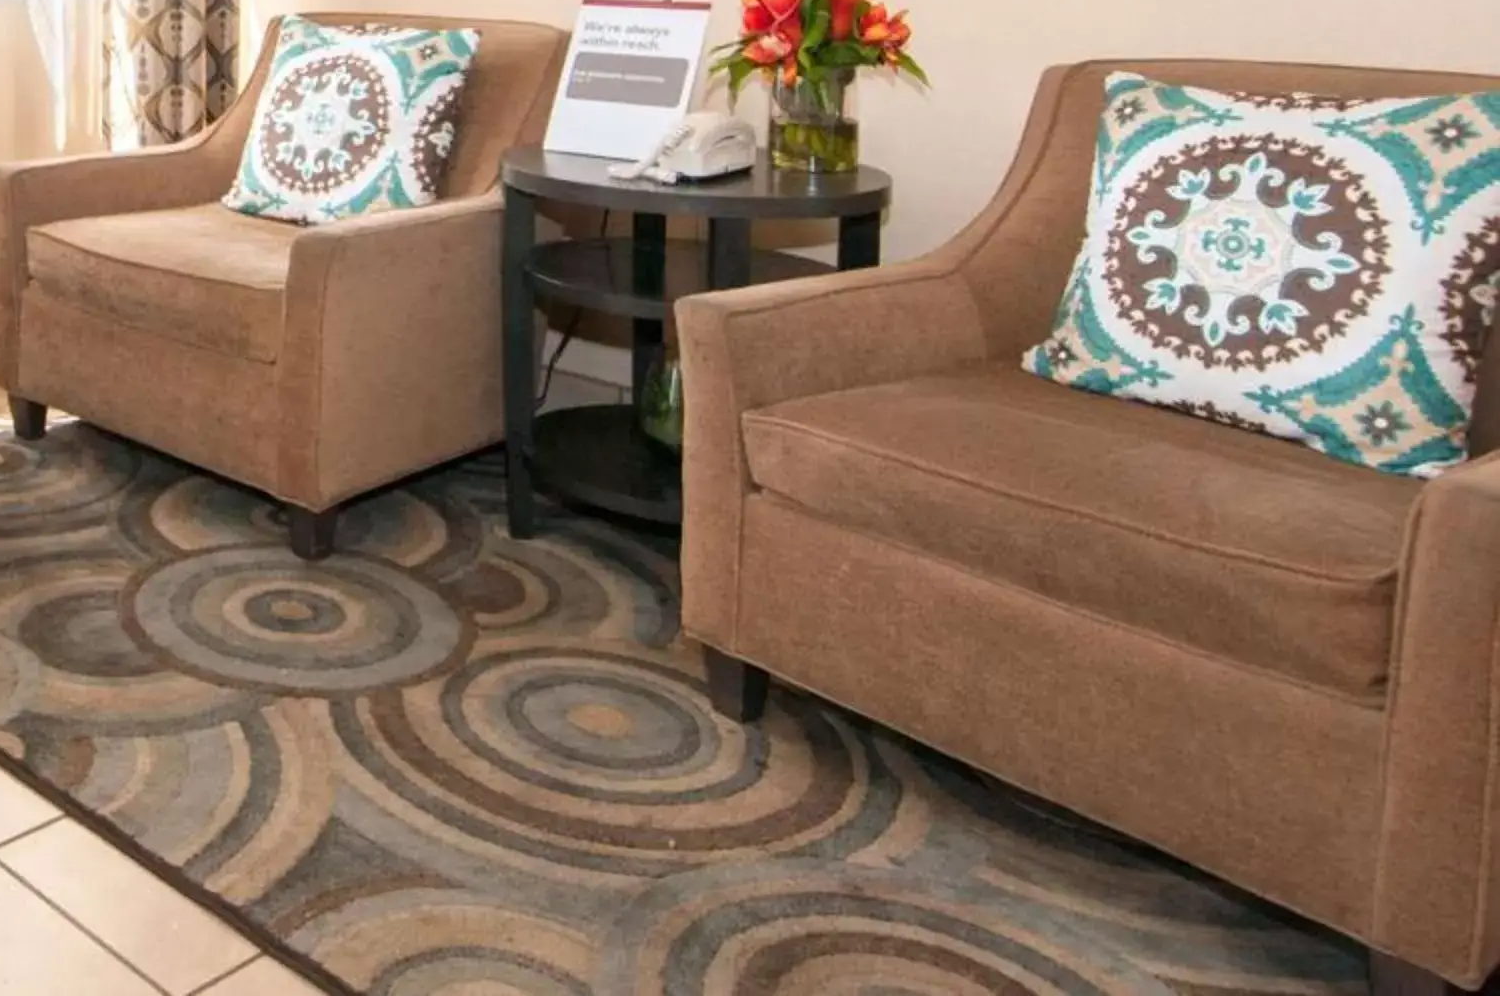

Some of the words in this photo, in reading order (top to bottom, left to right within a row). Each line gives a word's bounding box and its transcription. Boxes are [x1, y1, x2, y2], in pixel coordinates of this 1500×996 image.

[585, 21, 621, 33] We're
[626, 24, 670, 37] always
[580, 35, 618, 47] within
